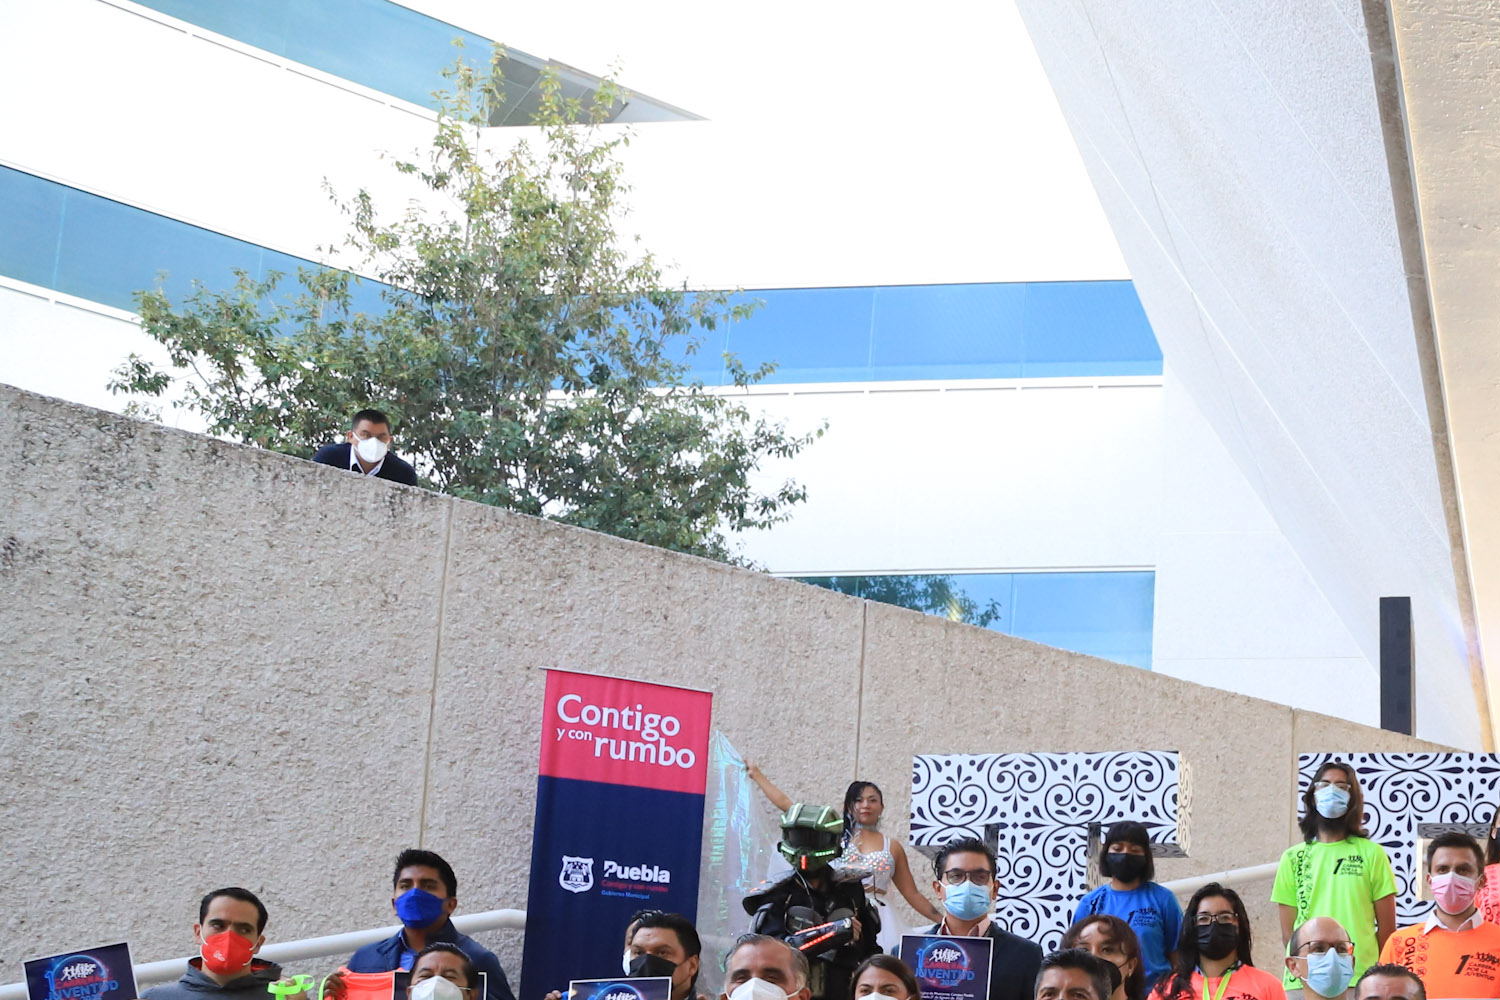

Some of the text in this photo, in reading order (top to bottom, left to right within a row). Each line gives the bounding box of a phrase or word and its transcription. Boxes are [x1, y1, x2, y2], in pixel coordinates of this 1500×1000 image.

[557, 694, 680, 741] Contigo
[557, 728, 592, 741] y con
[594, 737, 695, 769] rumbo
[604, 861, 670, 883] Puebla
[1469, 962, 1496, 971] CARRERA
[1465, 971, 1495, 981] JUVENTUD
